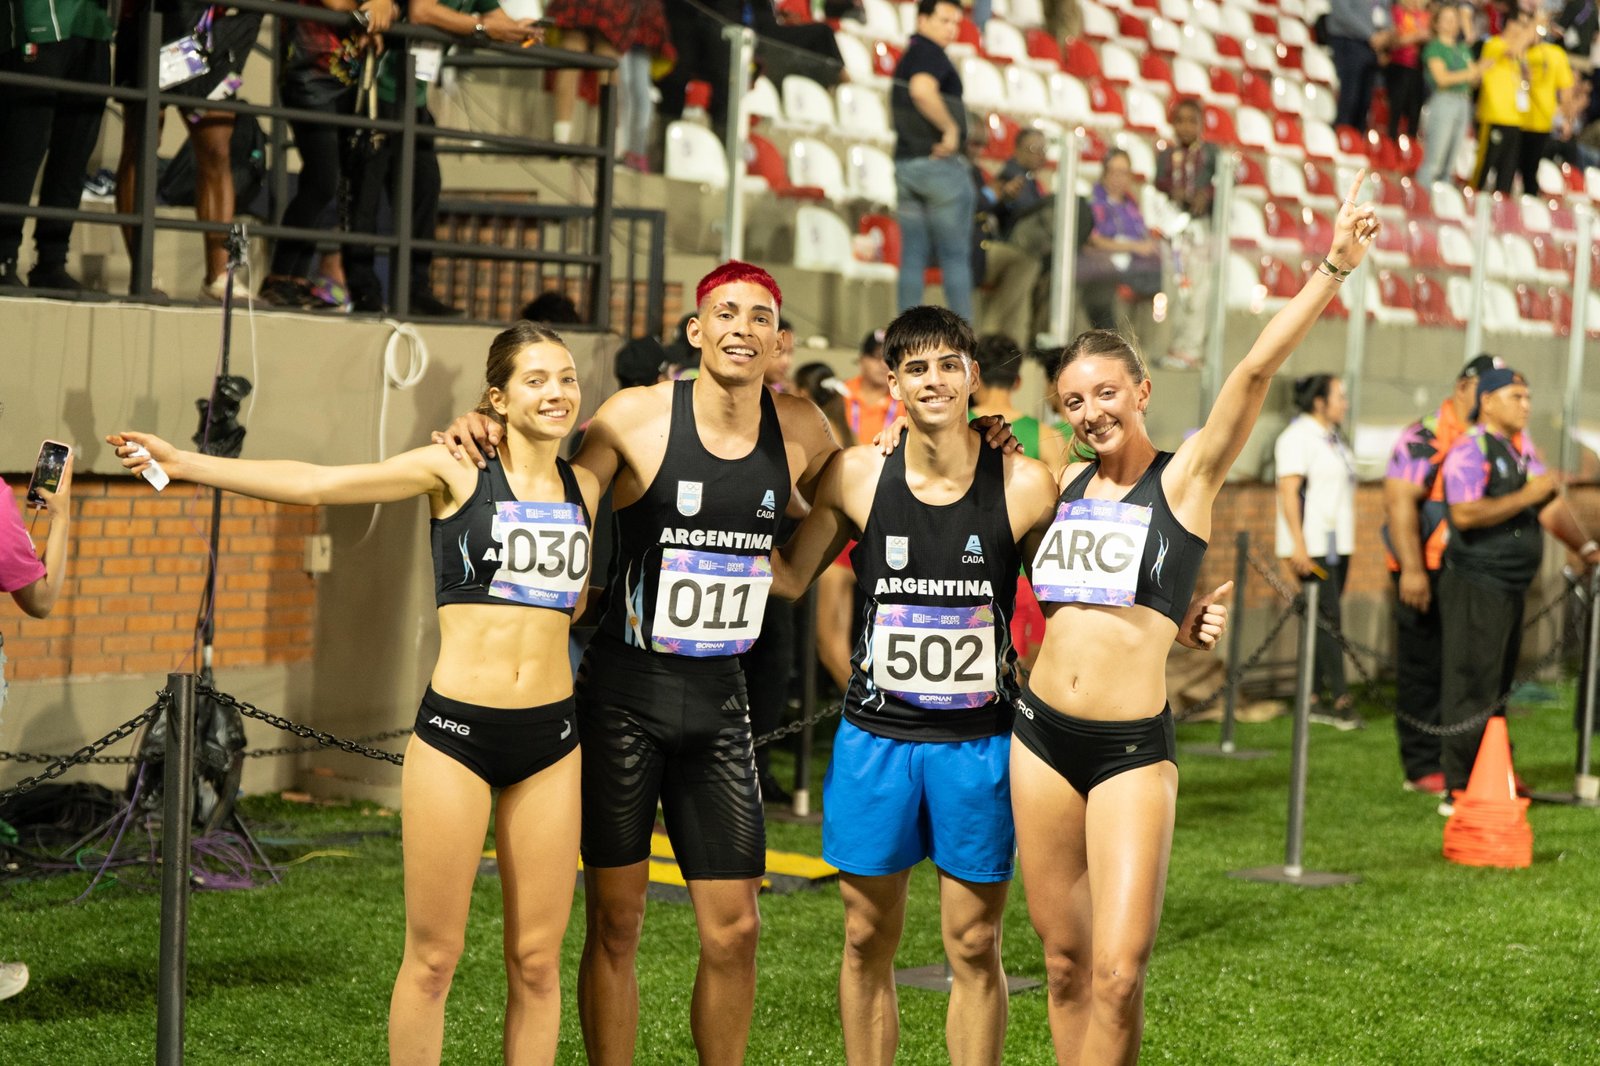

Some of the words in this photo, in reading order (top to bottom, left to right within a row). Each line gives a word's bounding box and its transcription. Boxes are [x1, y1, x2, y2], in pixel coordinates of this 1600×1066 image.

[756, 509, 775, 519] CADA
[659, 527, 773, 550] ARGENTINA
[507, 528, 590, 580] 030
[961, 555, 985, 564] CADA
[1035, 529, 1136, 574] ARG
[874, 577, 994, 597] ARGENTINA
[668, 578, 751, 629] 011
[886, 633, 984, 682] 502
[918, 694, 953, 702] BORNAN
[428, 715, 471, 736] ARG
